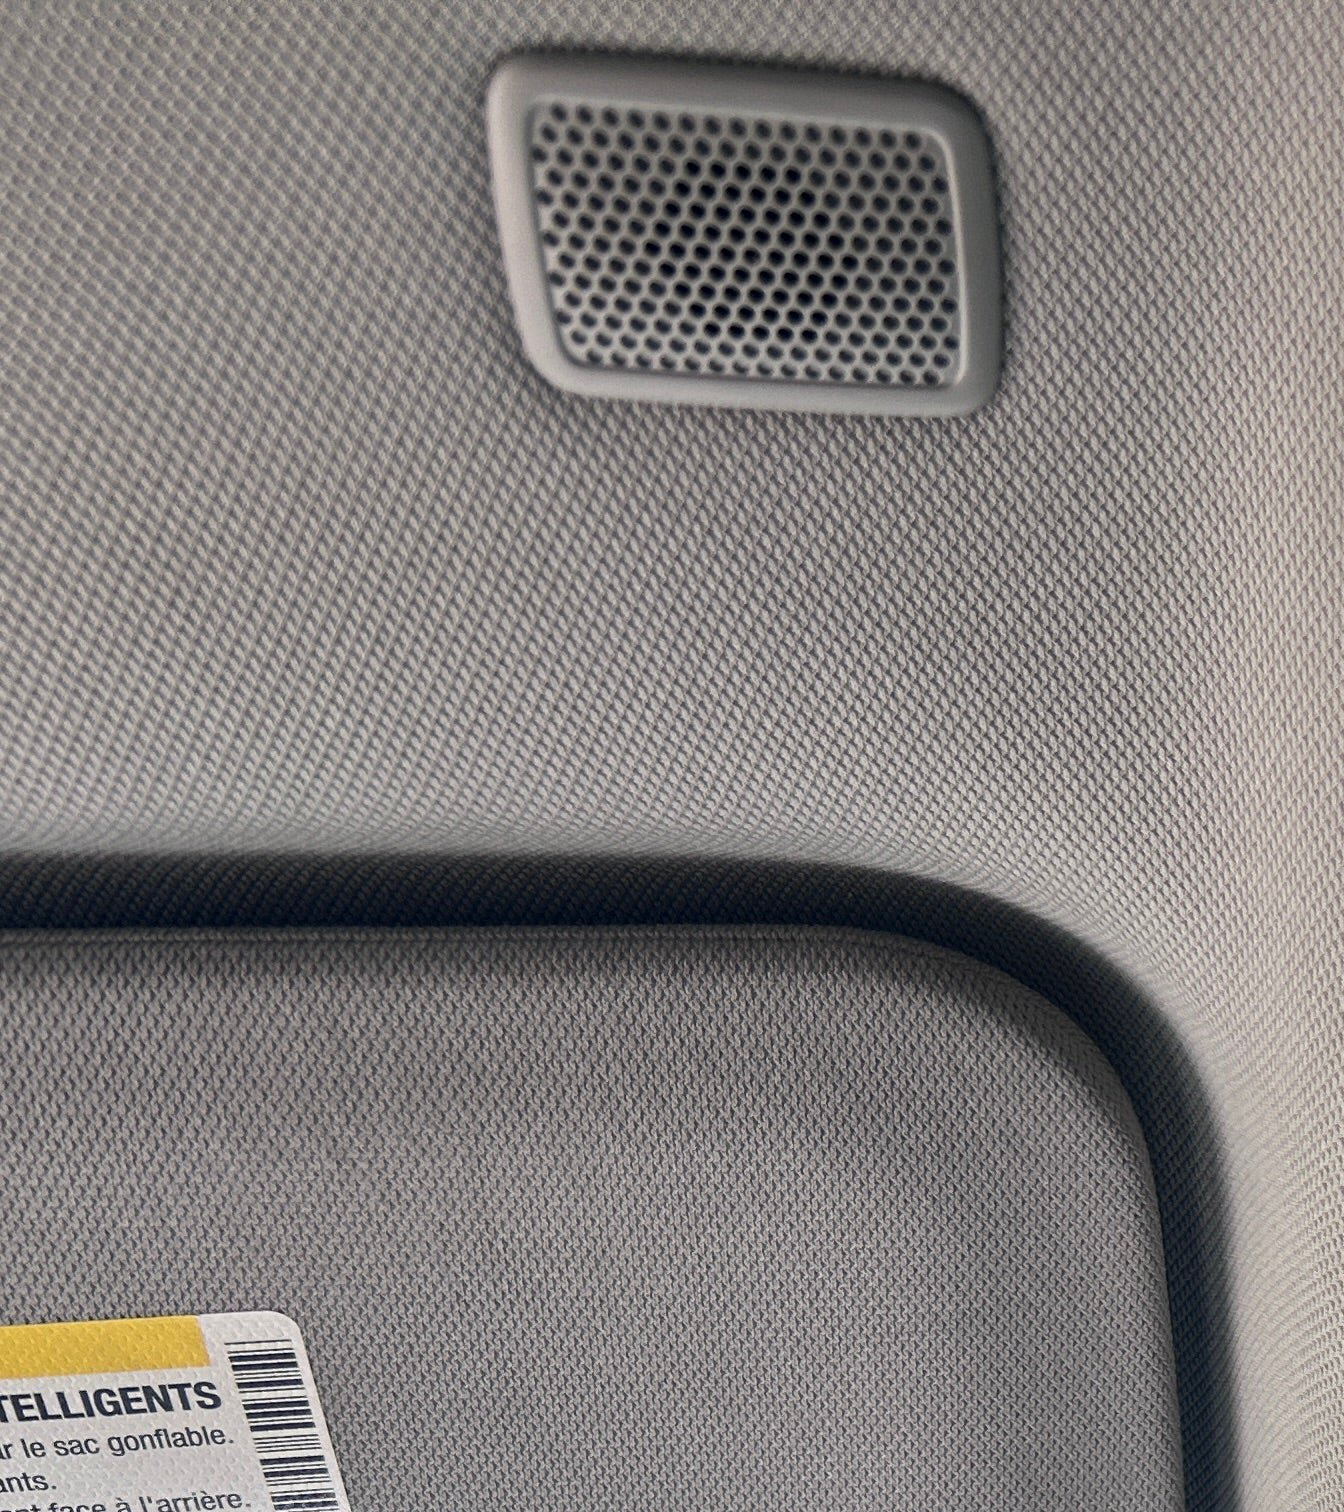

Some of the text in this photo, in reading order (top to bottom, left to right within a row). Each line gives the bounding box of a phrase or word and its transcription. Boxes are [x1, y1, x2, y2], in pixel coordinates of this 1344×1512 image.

[20, 1438, 46, 1459] le
[53, 1438, 100, 1457] sac
[107, 1425, 235, 1457] gonflable.
